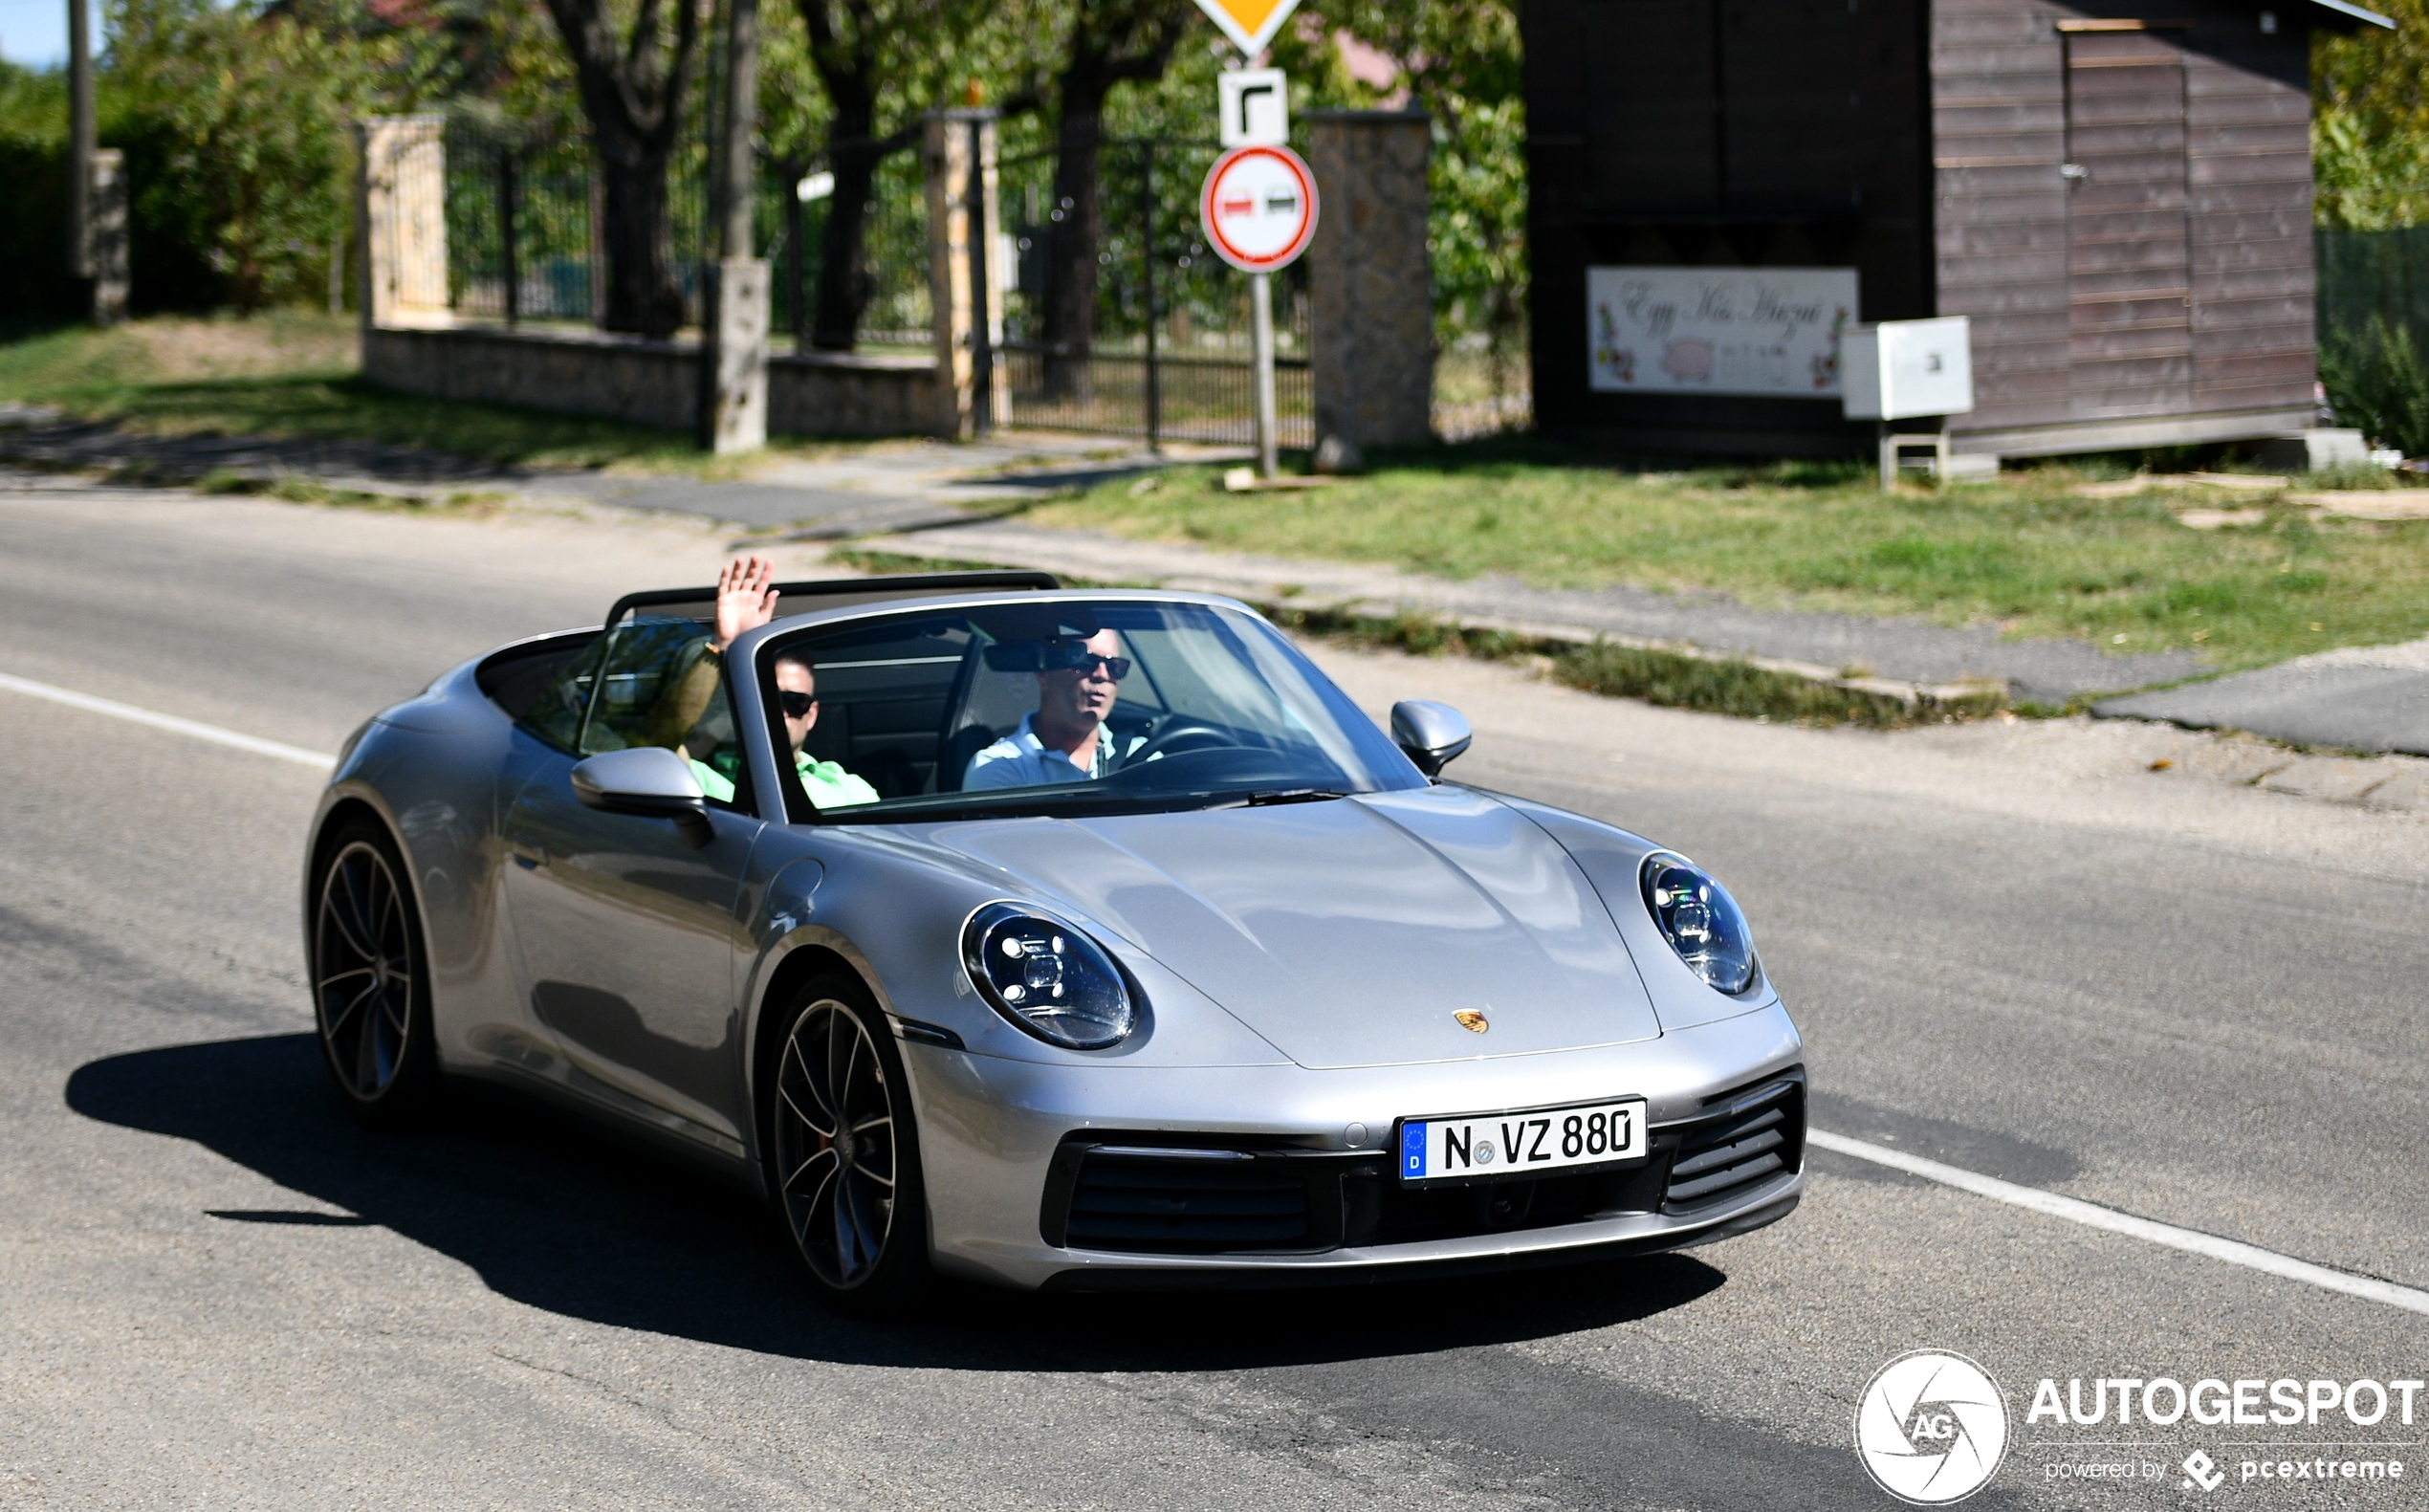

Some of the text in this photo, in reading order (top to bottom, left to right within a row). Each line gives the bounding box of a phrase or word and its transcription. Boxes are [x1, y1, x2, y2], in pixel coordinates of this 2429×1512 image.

[1445, 1109, 1631, 1170] N VZ 880
[1410, 1155, 1419, 1169] D
